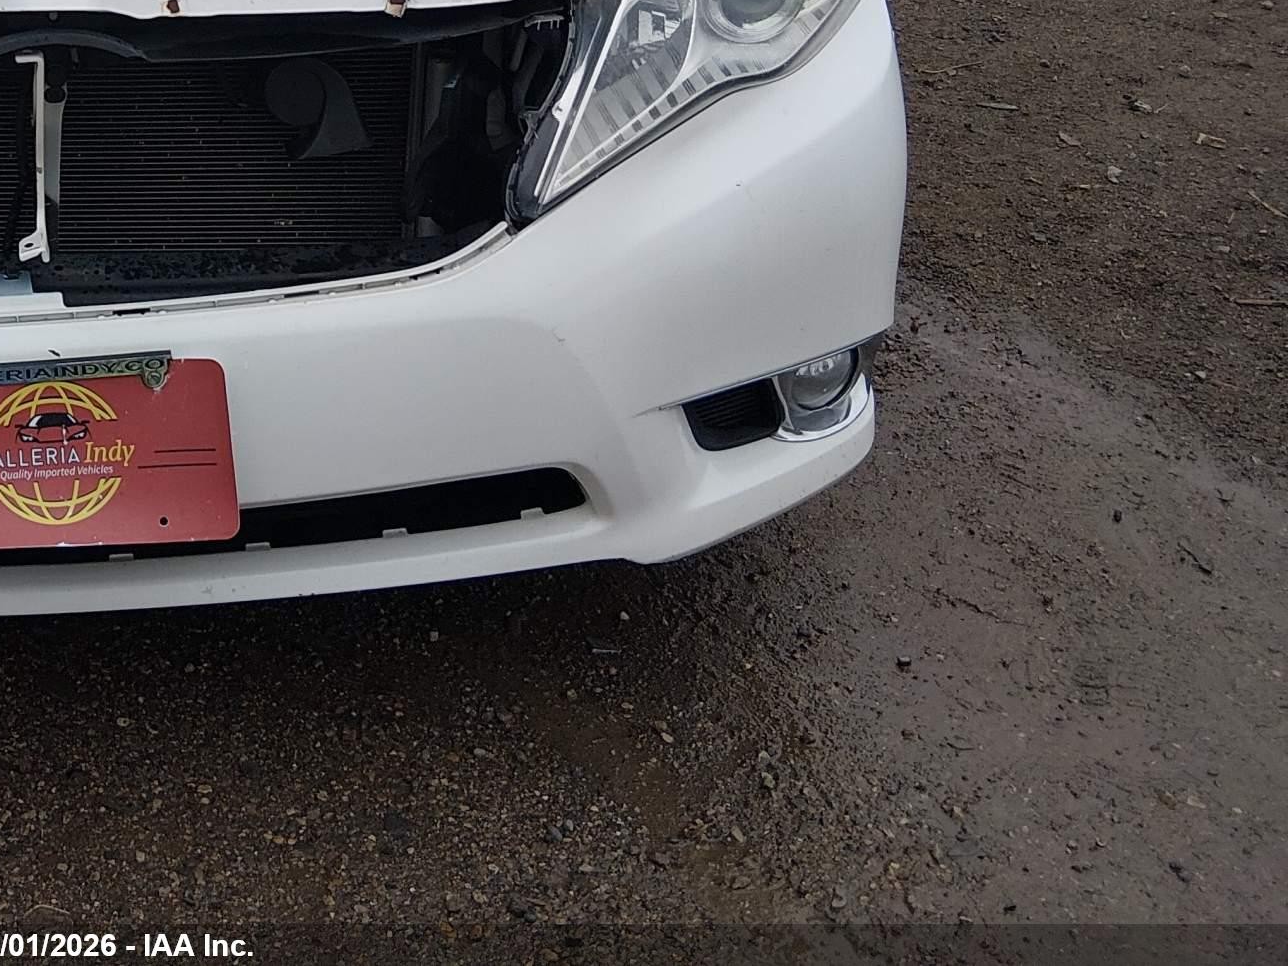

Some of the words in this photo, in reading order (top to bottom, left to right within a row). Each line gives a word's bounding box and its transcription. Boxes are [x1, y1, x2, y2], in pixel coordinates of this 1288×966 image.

[83, 439, 135, 467] Indy
[0, 468, 33, 481] Quality
[34, 466, 75, 479] Imported
[77, 464, 113, 475] Vehicles
